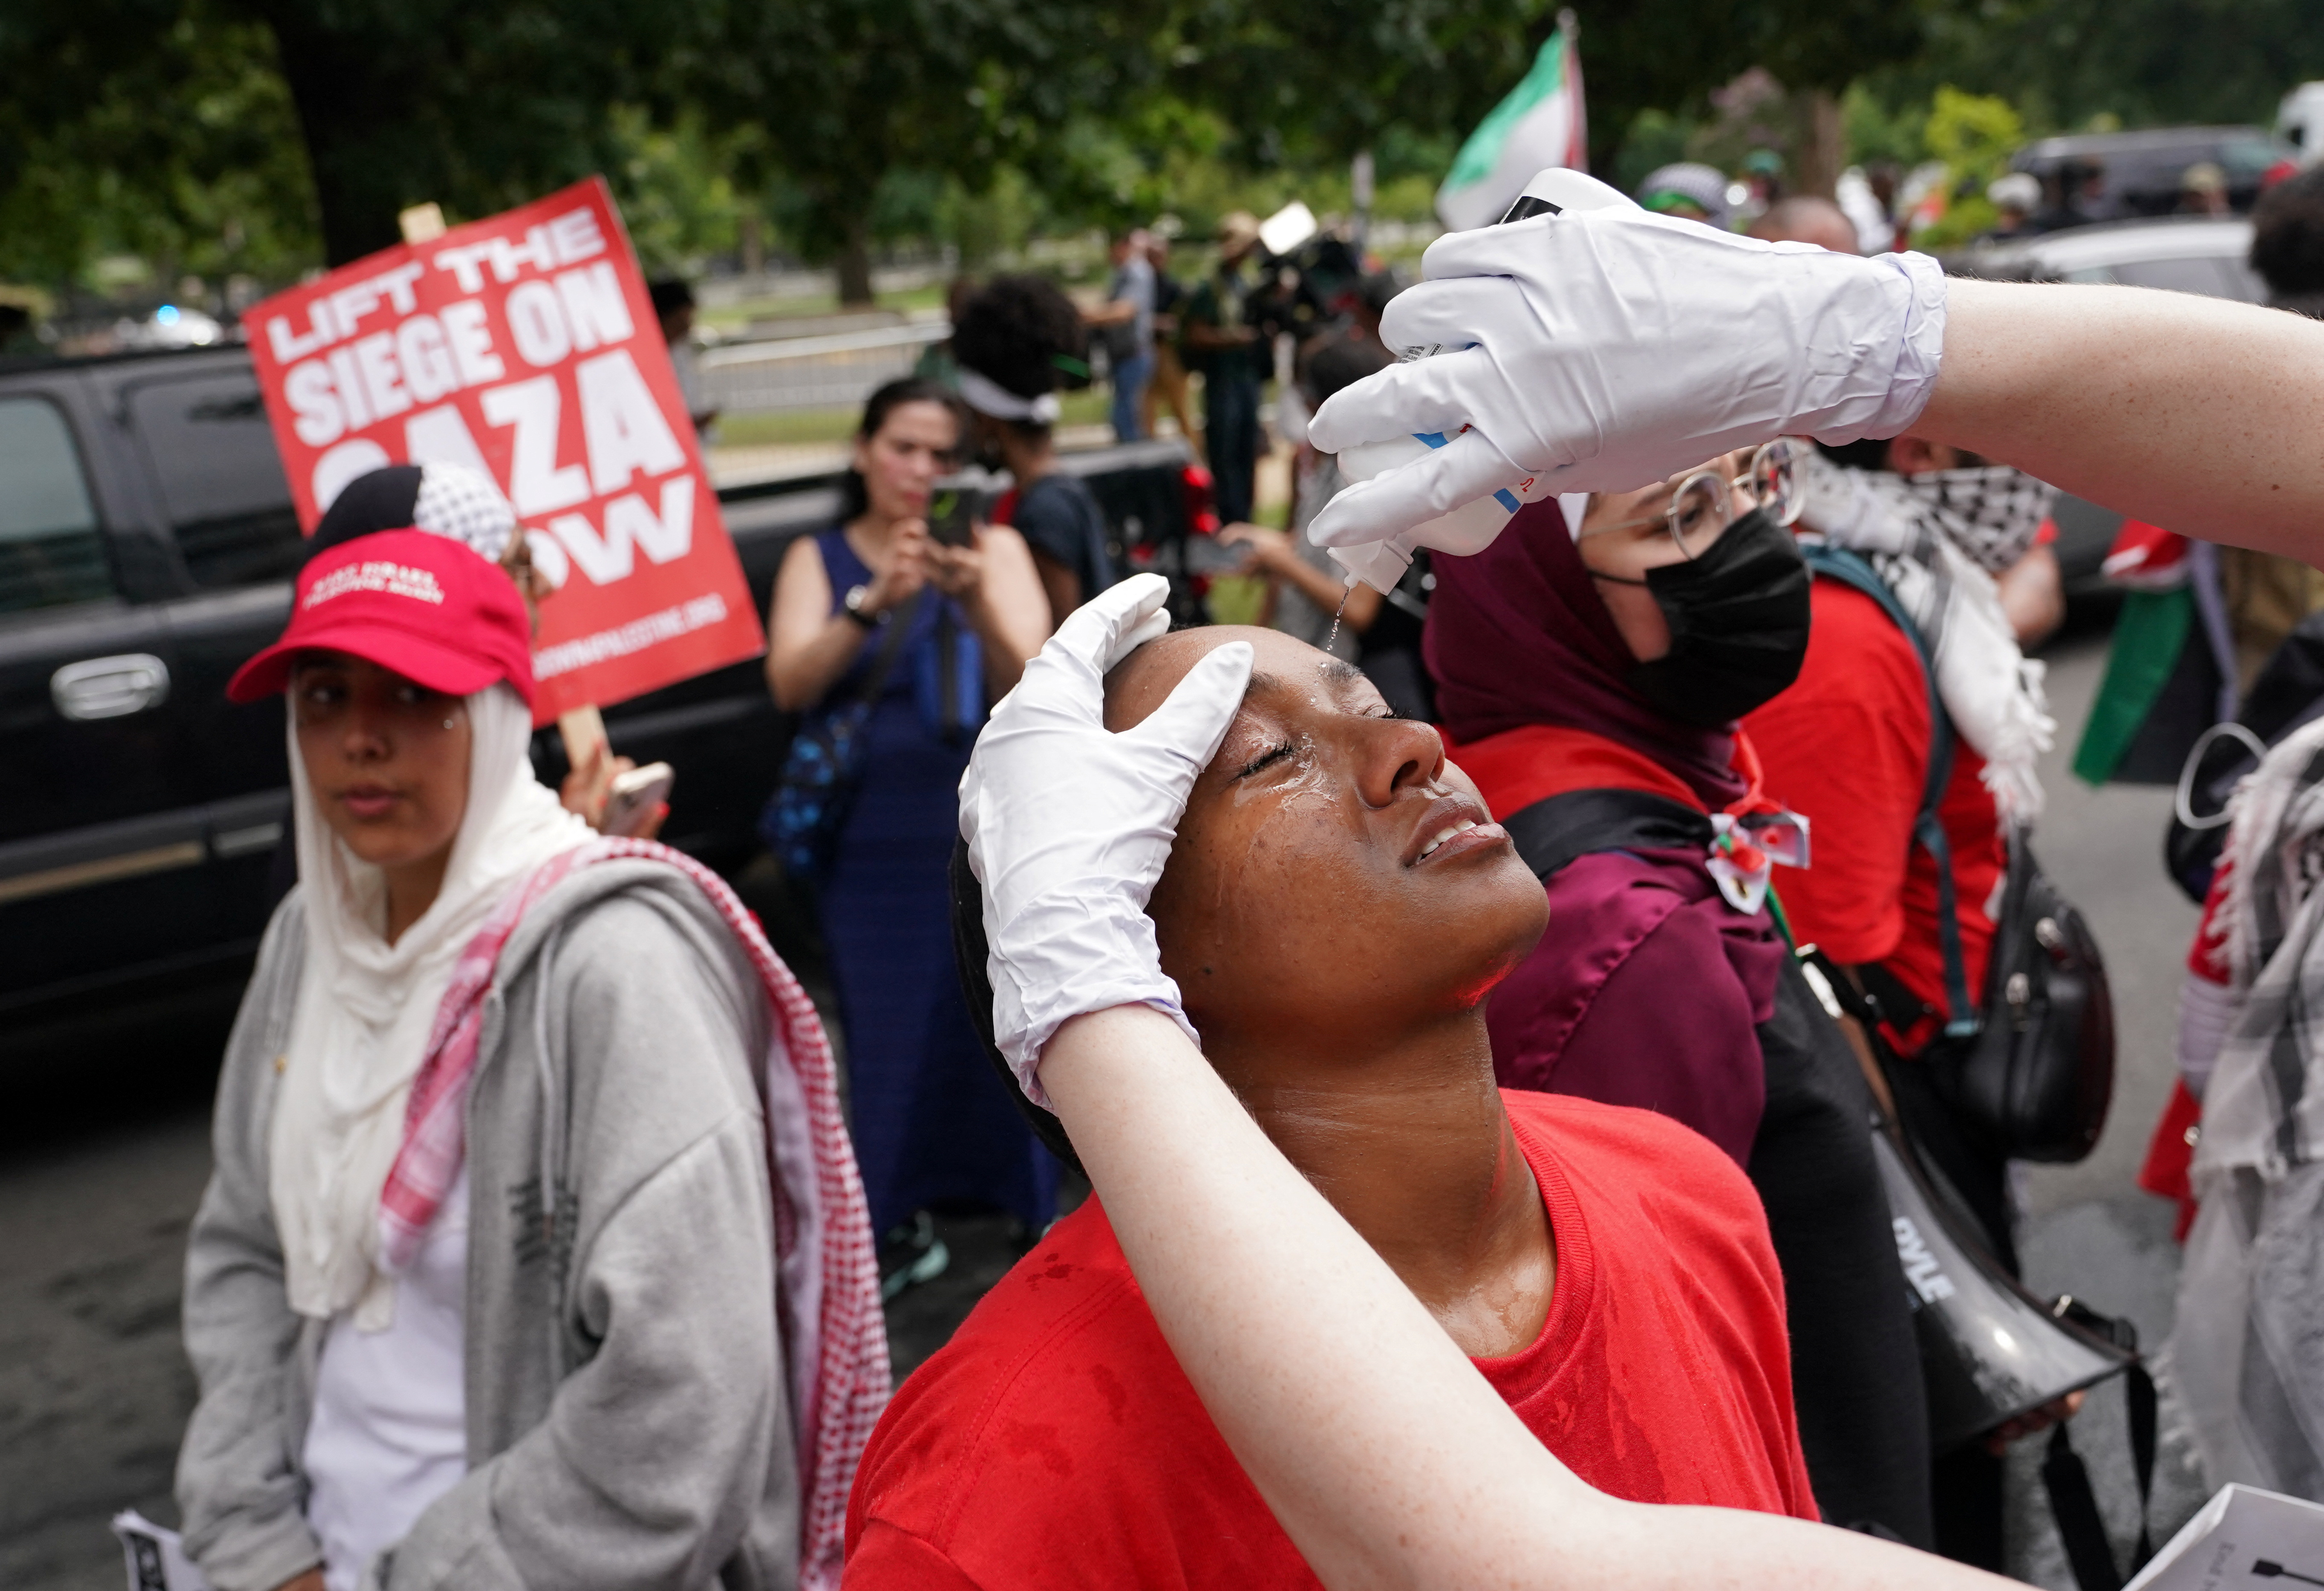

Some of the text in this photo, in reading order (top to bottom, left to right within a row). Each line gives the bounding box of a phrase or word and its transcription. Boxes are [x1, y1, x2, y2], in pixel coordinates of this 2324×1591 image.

[266, 206, 607, 365] LIFT THE
[284, 260, 635, 446] SIEGE ON
